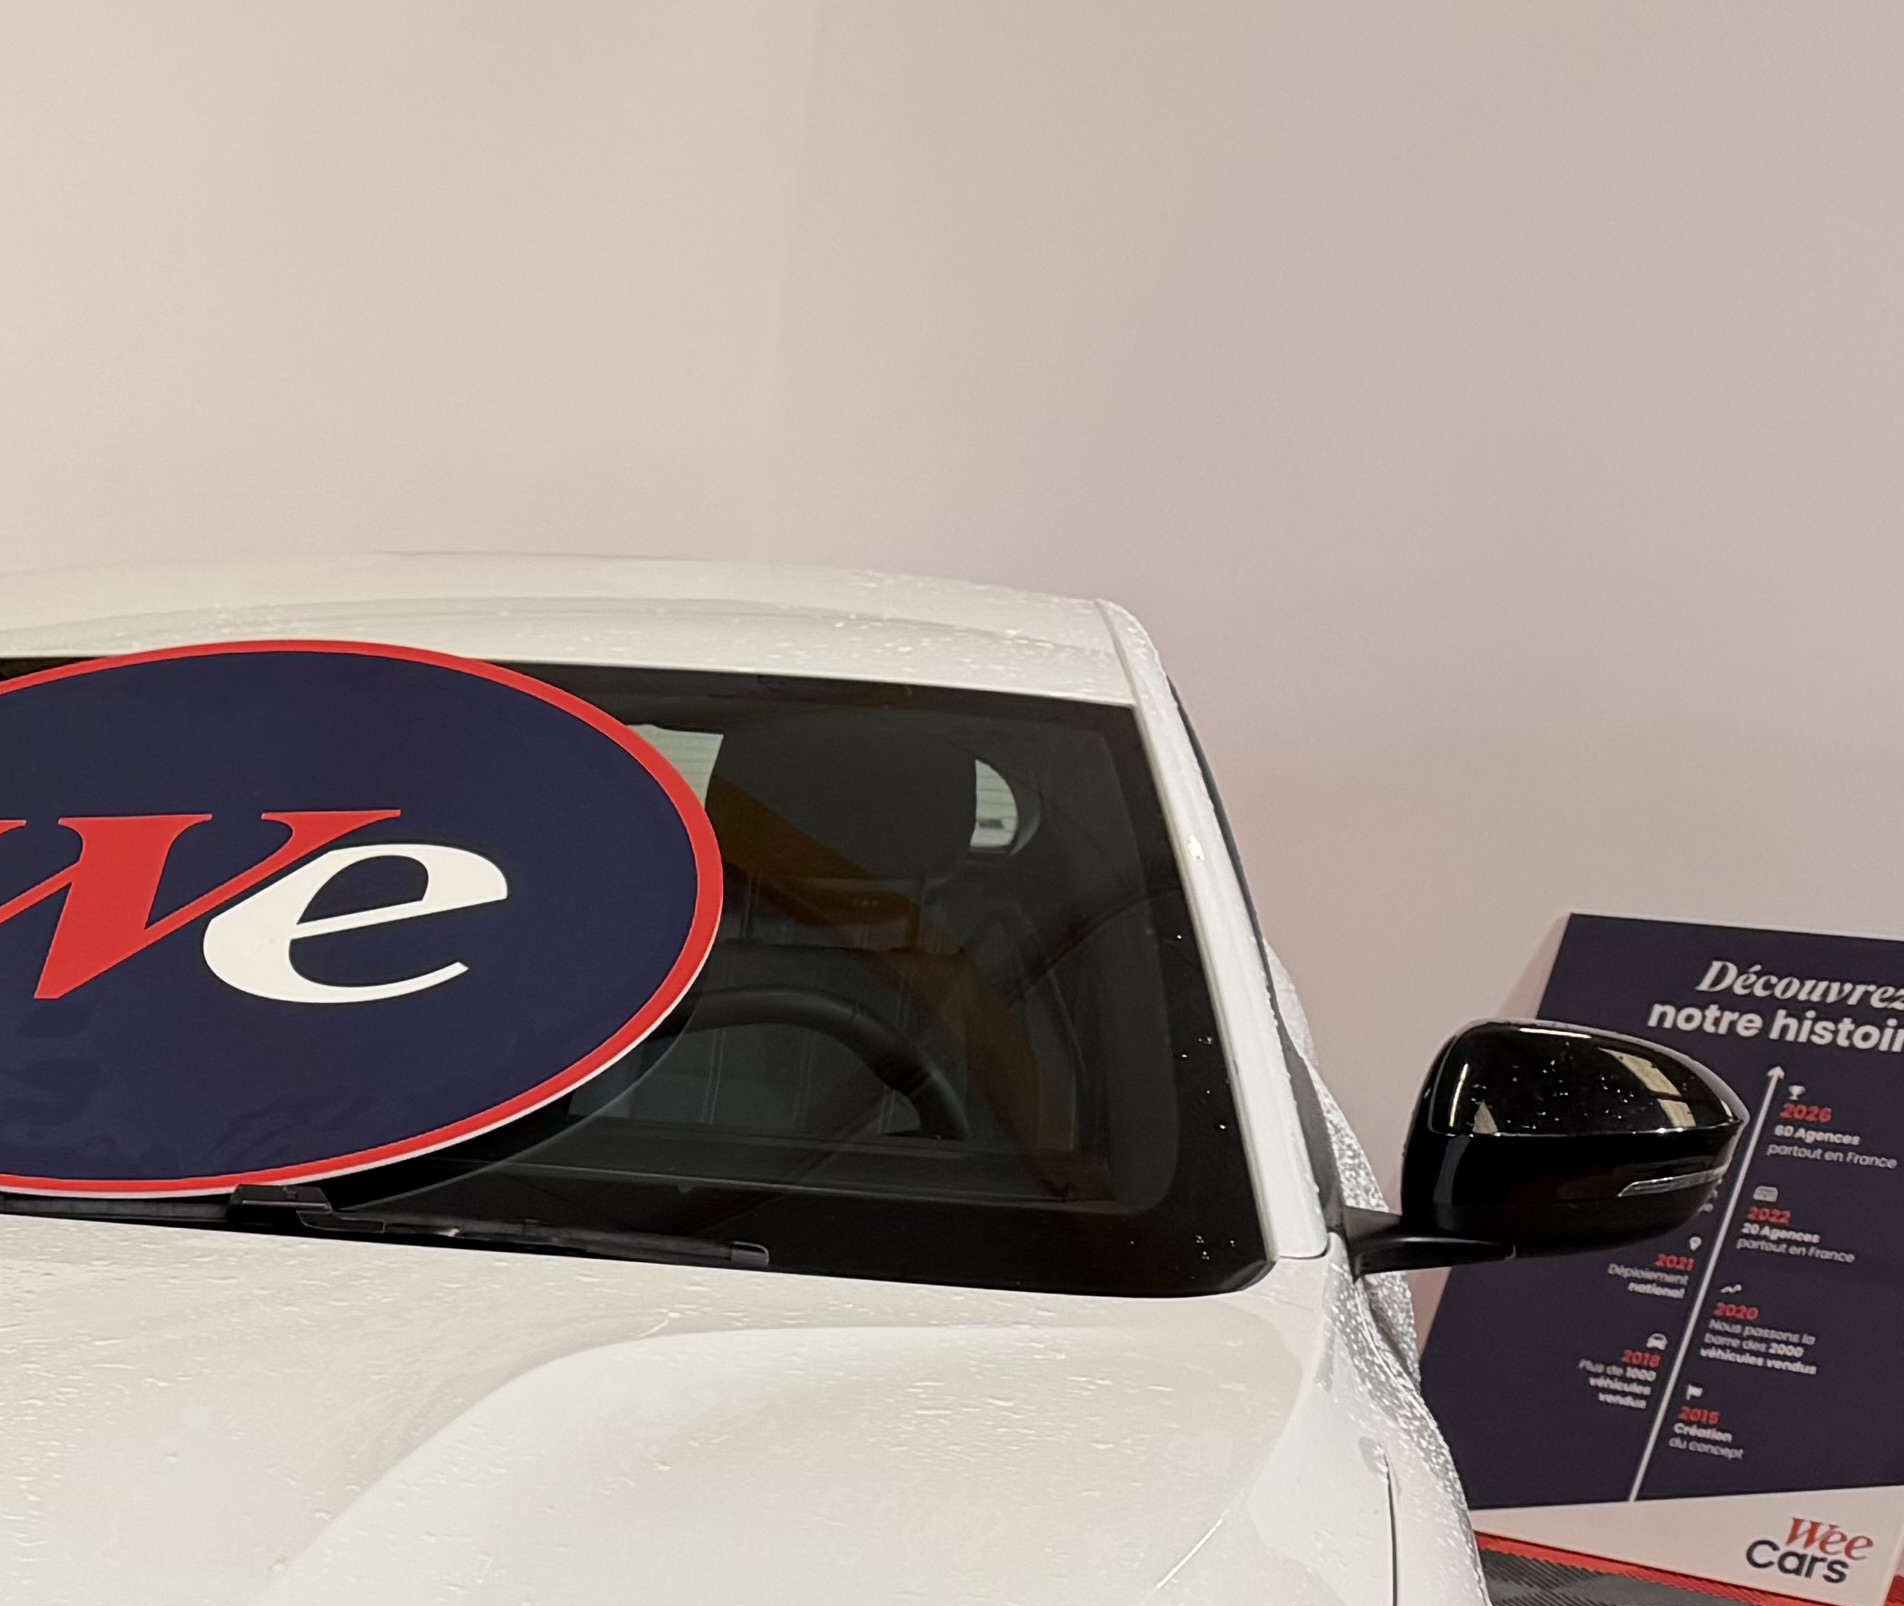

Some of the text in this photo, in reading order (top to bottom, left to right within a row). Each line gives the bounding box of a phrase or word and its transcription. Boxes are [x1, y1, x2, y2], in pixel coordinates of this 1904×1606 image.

[1695, 960, 1904, 1010] Découvrez
[1647, 1003, 1763, 1037] notre
[1780, 1103, 1832, 1123] 2026
[1794, 1127, 1861, 1146] Agences
[1766, 1143, 1898, 1169] partout en France
[1747, 1206, 1792, 1224] 2022
[1741, 1222, 1821, 1244] 20 Agences
[1736, 1237, 1856, 1263] partout en France
[1628, 1282, 1686, 1299] national
[1713, 1302, 1760, 1320] 2020
[1743, 1325, 1800, 1343] passons
[1700, 1346, 1817, 1376] véhicules vendus
[1673, 1422, 1733, 1443] Création
[1668, 1436, 1744, 1460] du concept
[1785, 1516, 1874, 1561] Wee
[1746, 1539, 1849, 1584] Cars
